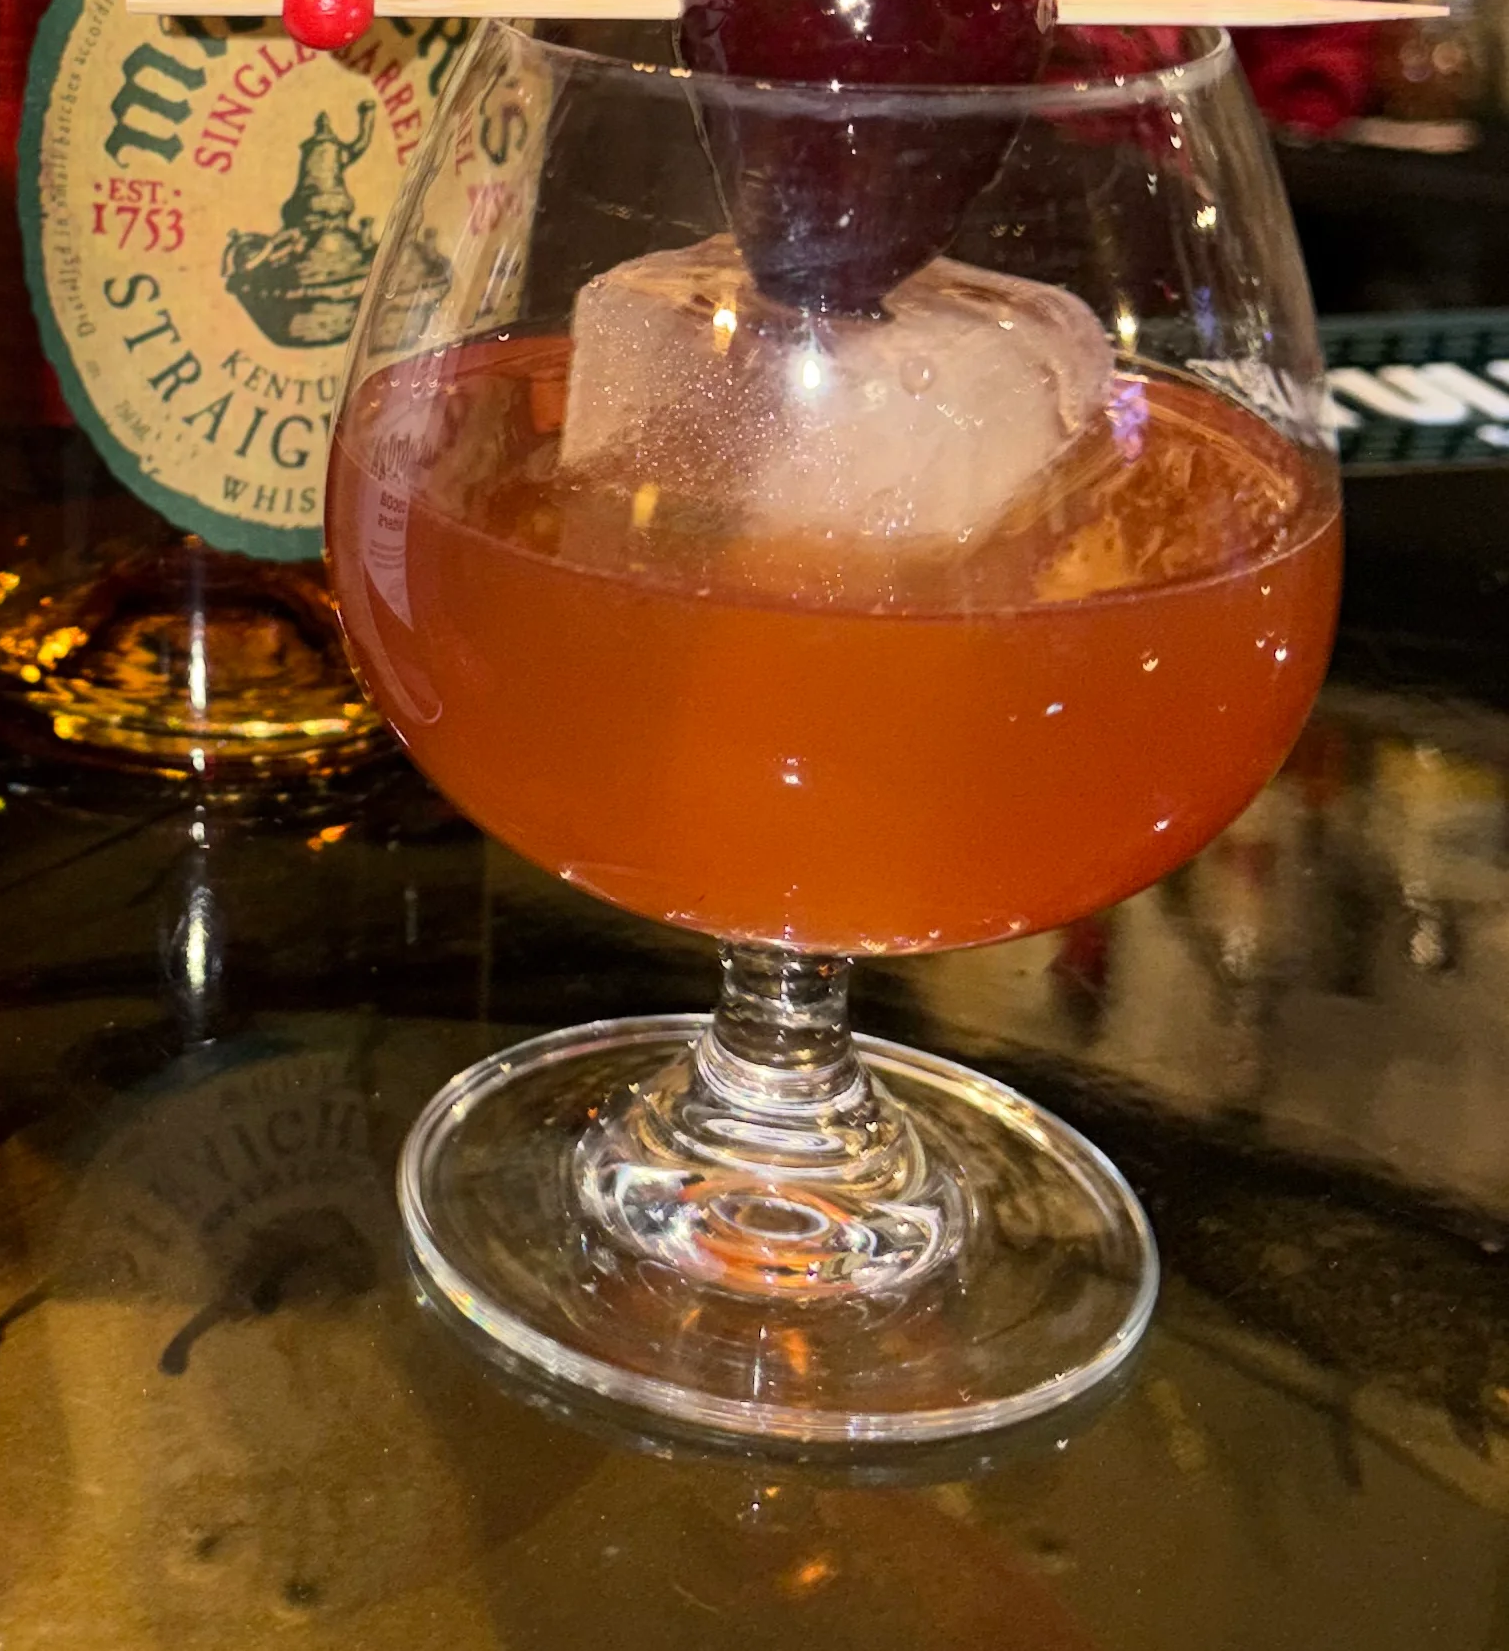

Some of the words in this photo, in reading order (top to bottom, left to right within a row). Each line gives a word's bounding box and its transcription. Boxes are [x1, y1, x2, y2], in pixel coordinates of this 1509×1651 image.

[53, 72, 83, 147] batches
[194, 41, 317, 175] SINGLE
[92, 202, 185, 252] 1753
